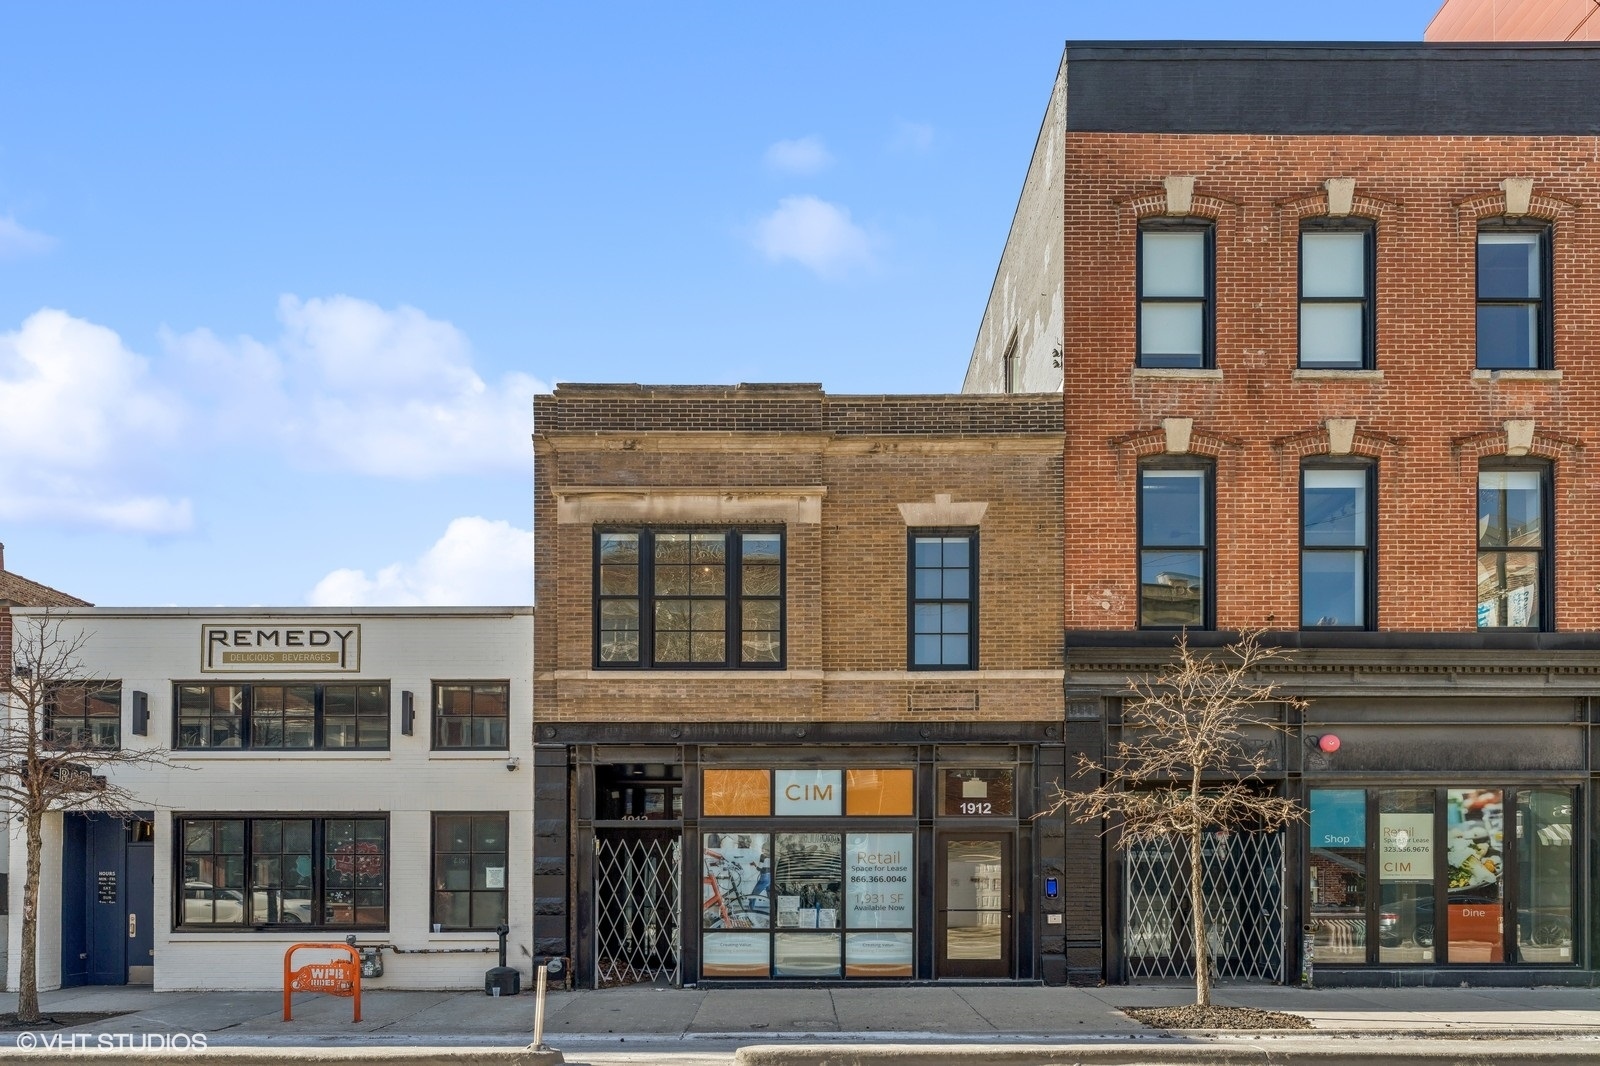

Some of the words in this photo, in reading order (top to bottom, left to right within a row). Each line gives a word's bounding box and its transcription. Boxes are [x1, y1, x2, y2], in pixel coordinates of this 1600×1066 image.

[208, 630, 353, 668] REMEDY
[230, 653, 275, 662] DELICIOUS
[282, 653, 331, 662] BEVERAGES
[785, 784, 832, 801] CIM
[960, 802, 992, 814] 1912
[1324, 834, 1350, 845] Shop
[857, 851, 900, 864] Retail
[1384, 862, 1411, 872] CIM
[855, 894, 885, 904] 1,931
[890, 894, 904, 904] SF
[1462, 909, 1486, 917] Dine
